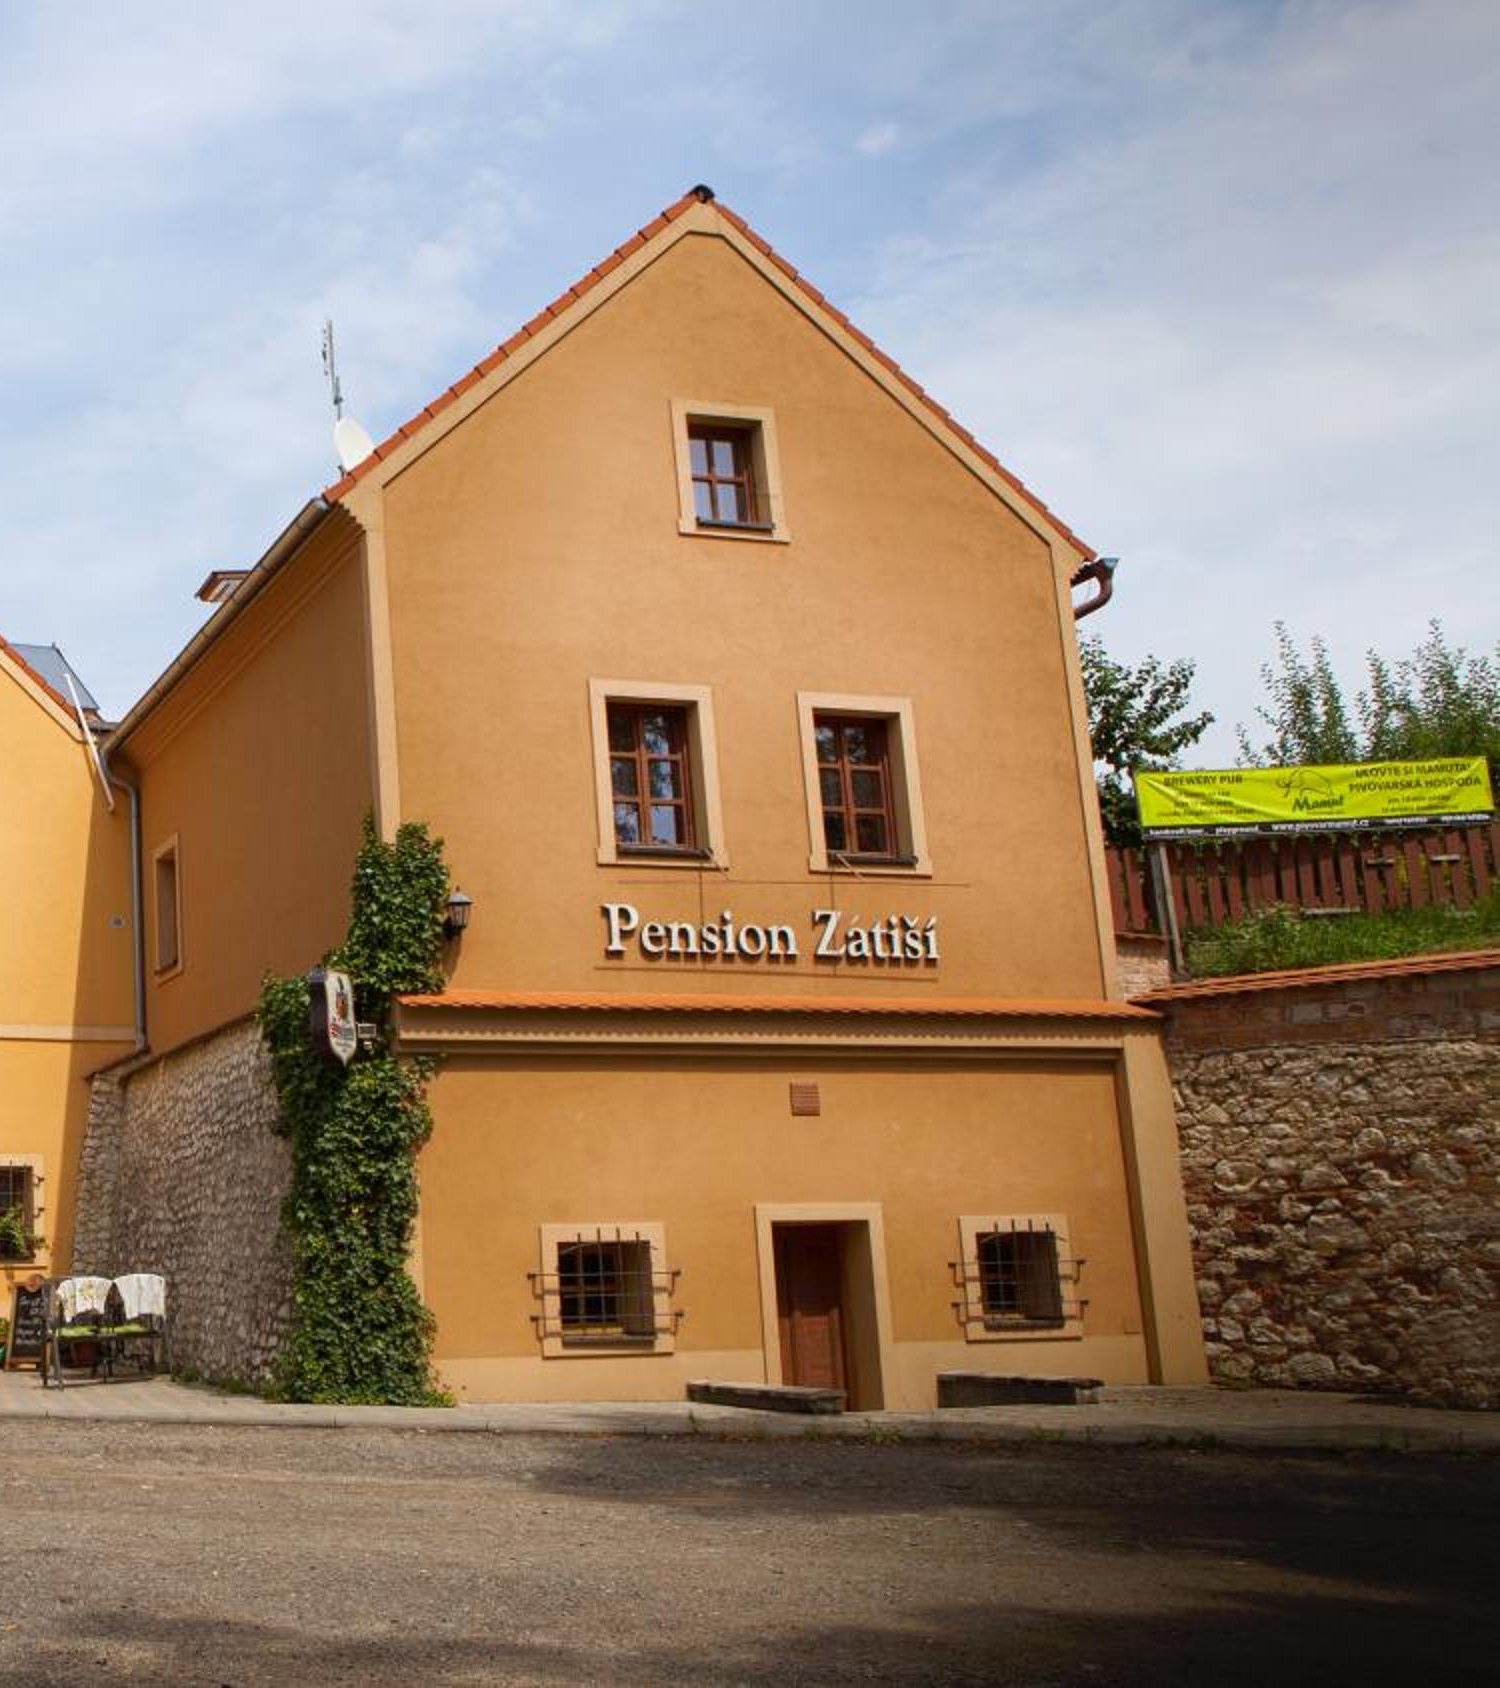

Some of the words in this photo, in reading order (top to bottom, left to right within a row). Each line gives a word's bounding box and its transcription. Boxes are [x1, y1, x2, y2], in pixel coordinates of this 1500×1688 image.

[1164, 775, 1216, 787] BREWERY
[1220, 774, 1243, 785] PUB
[602, 903, 798, 956] Pension
[813, 910, 941, 960] Zátiší
